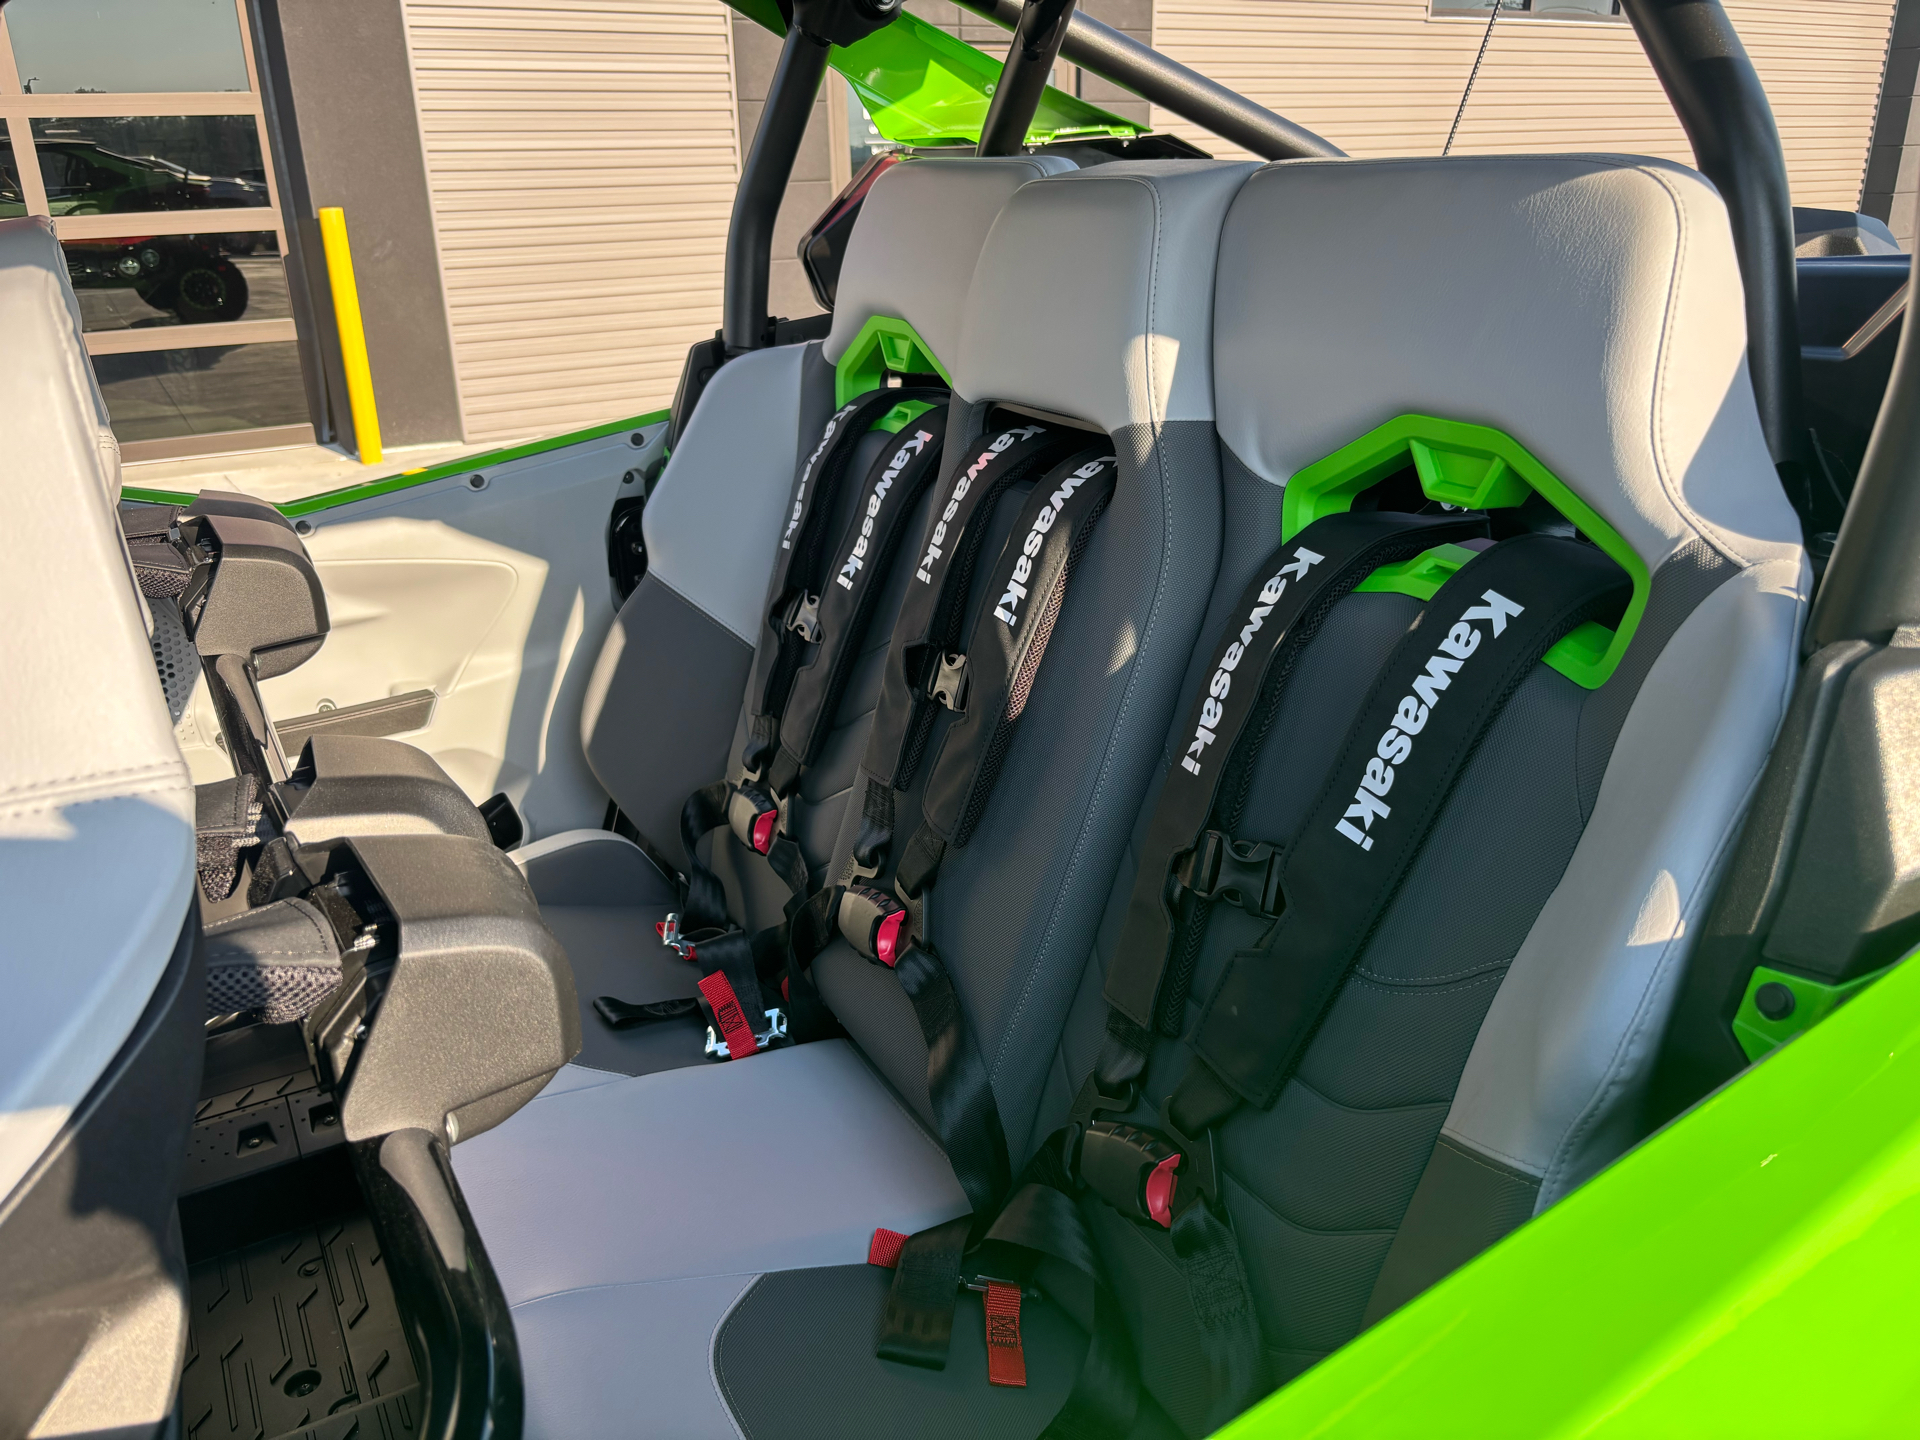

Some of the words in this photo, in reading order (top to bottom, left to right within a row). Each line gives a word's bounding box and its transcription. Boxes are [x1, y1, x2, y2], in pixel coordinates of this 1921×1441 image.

[782, 405, 857, 550] Kawasaki
[836, 429, 933, 591] Kawasaki
[916, 425, 1047, 585] Kawasaki
[1181, 546, 1325, 776] Kawasaki
[1334, 589, 1525, 851] Kawasaki
